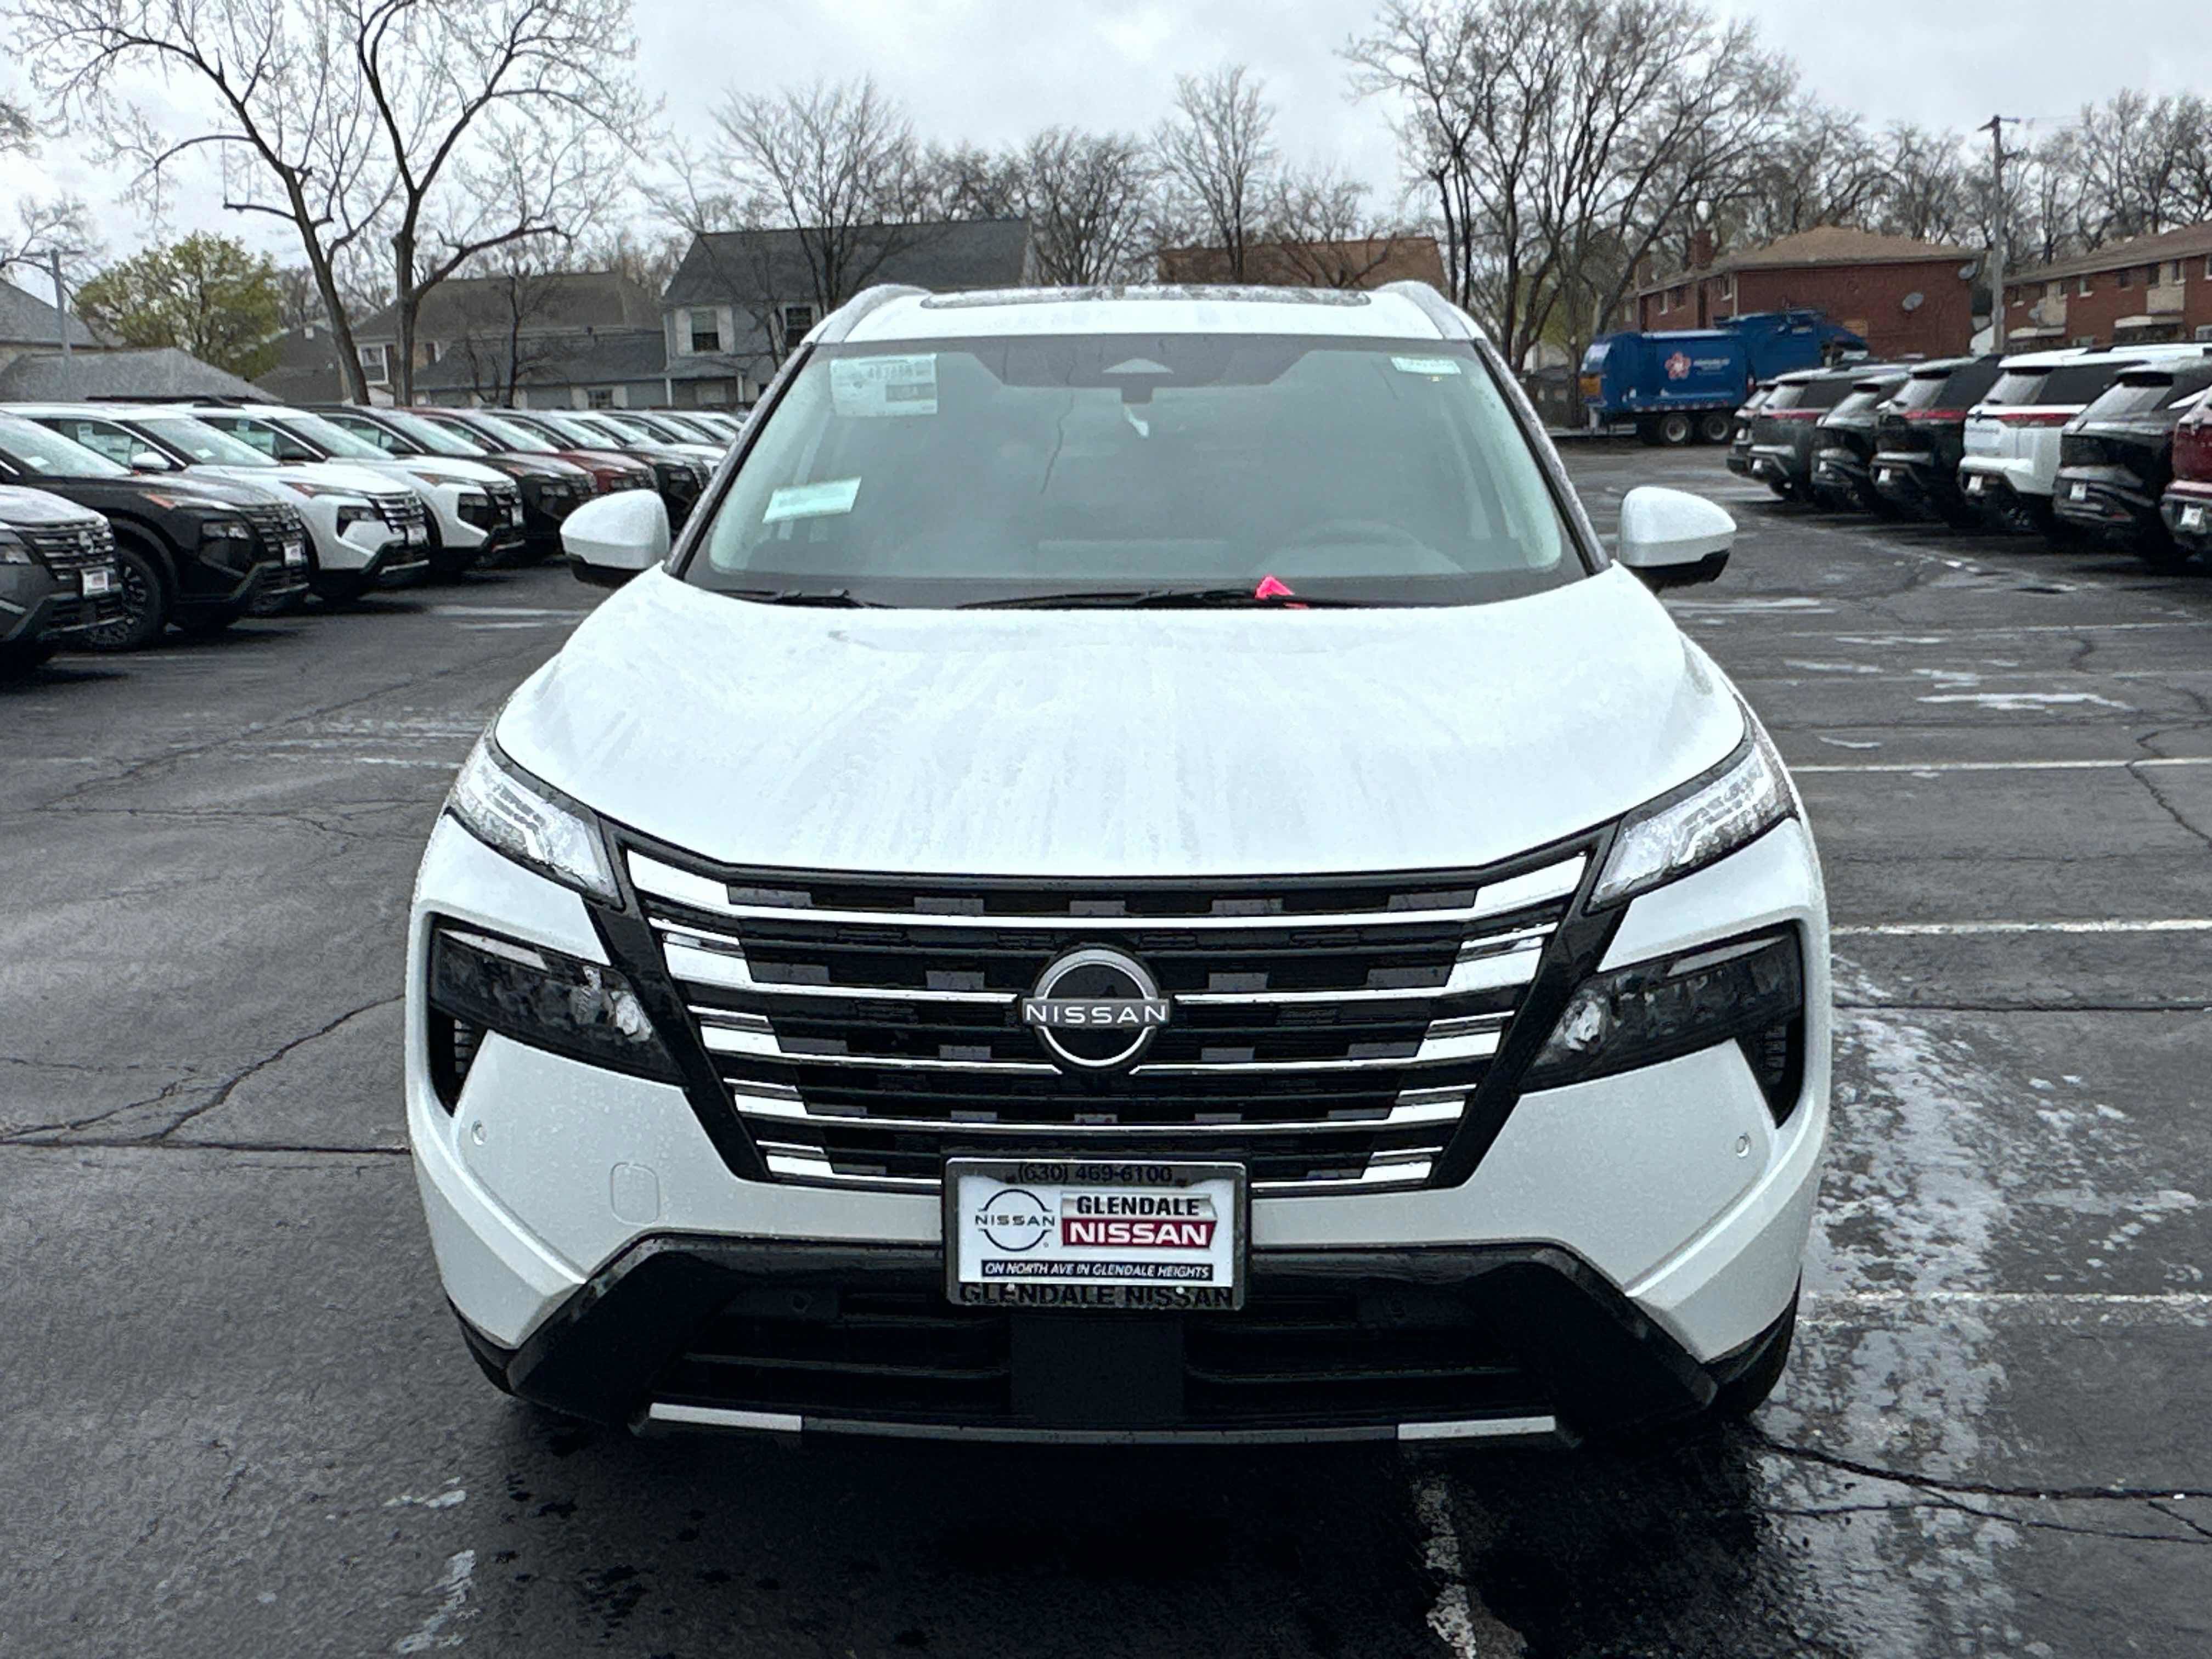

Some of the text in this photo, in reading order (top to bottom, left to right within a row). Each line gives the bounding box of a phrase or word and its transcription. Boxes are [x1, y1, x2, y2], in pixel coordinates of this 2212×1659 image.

[1025, 1003, 1166, 1024] NISSAN
[1018, 1164, 1068, 1182] (630)
[1076, 1195, 1200, 1216] GLENDALE
[975, 1214, 1055, 1227] NISSAN
[1069, 1223, 1206, 1245] NISSAN
[985, 1263, 1210, 1278] ON NORTH AVE IN GLENDALE HEIGHTS
[959, 1284, 1234, 1307] GLENDALE NISSAN
